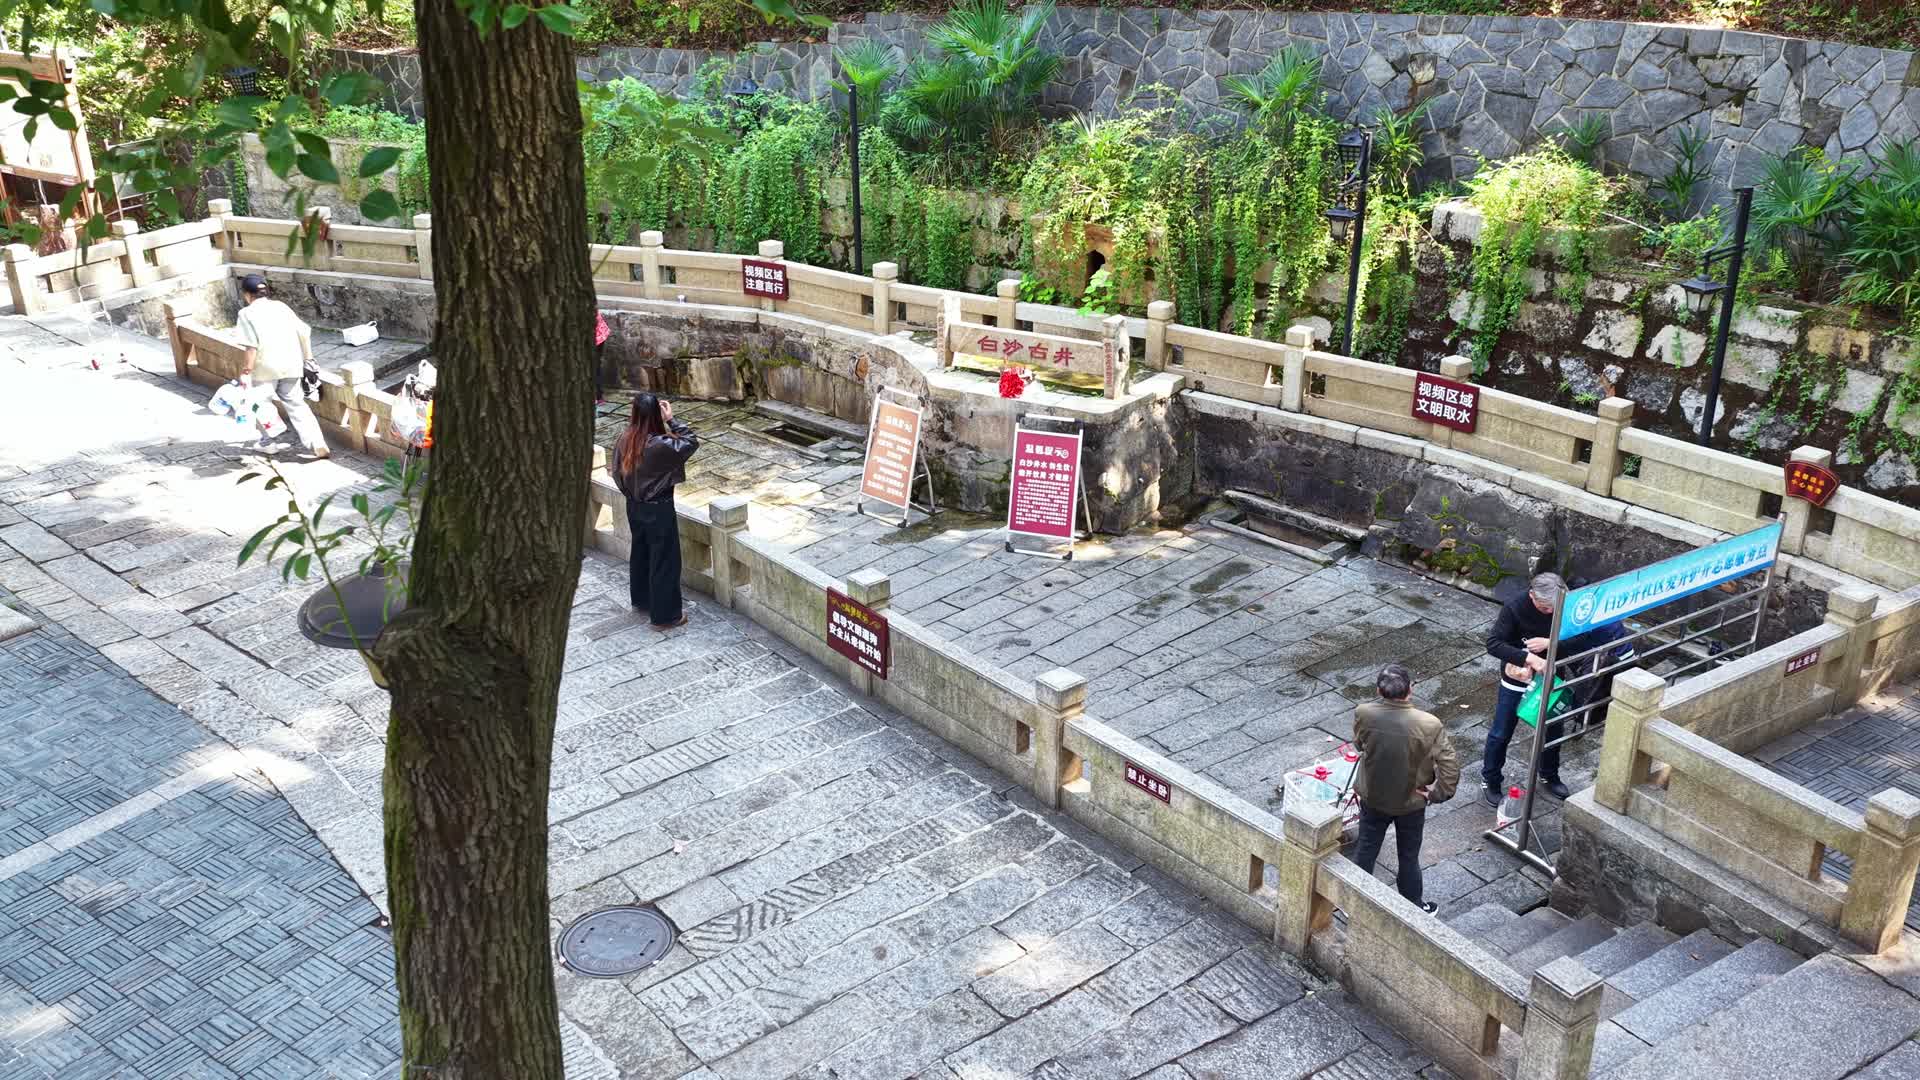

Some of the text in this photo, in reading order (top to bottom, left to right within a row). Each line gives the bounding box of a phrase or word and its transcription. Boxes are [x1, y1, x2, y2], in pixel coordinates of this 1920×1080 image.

[744, 265, 783, 281] 视频区域
[745, 278, 783, 294] 注意言行
[977, 335, 1075, 366] 白沙古井
[1418, 381, 1474, 408] 视频区域
[1416, 398, 1471, 424] 文明取水
[1128, 767, 1168, 798] 禁止坐卧
